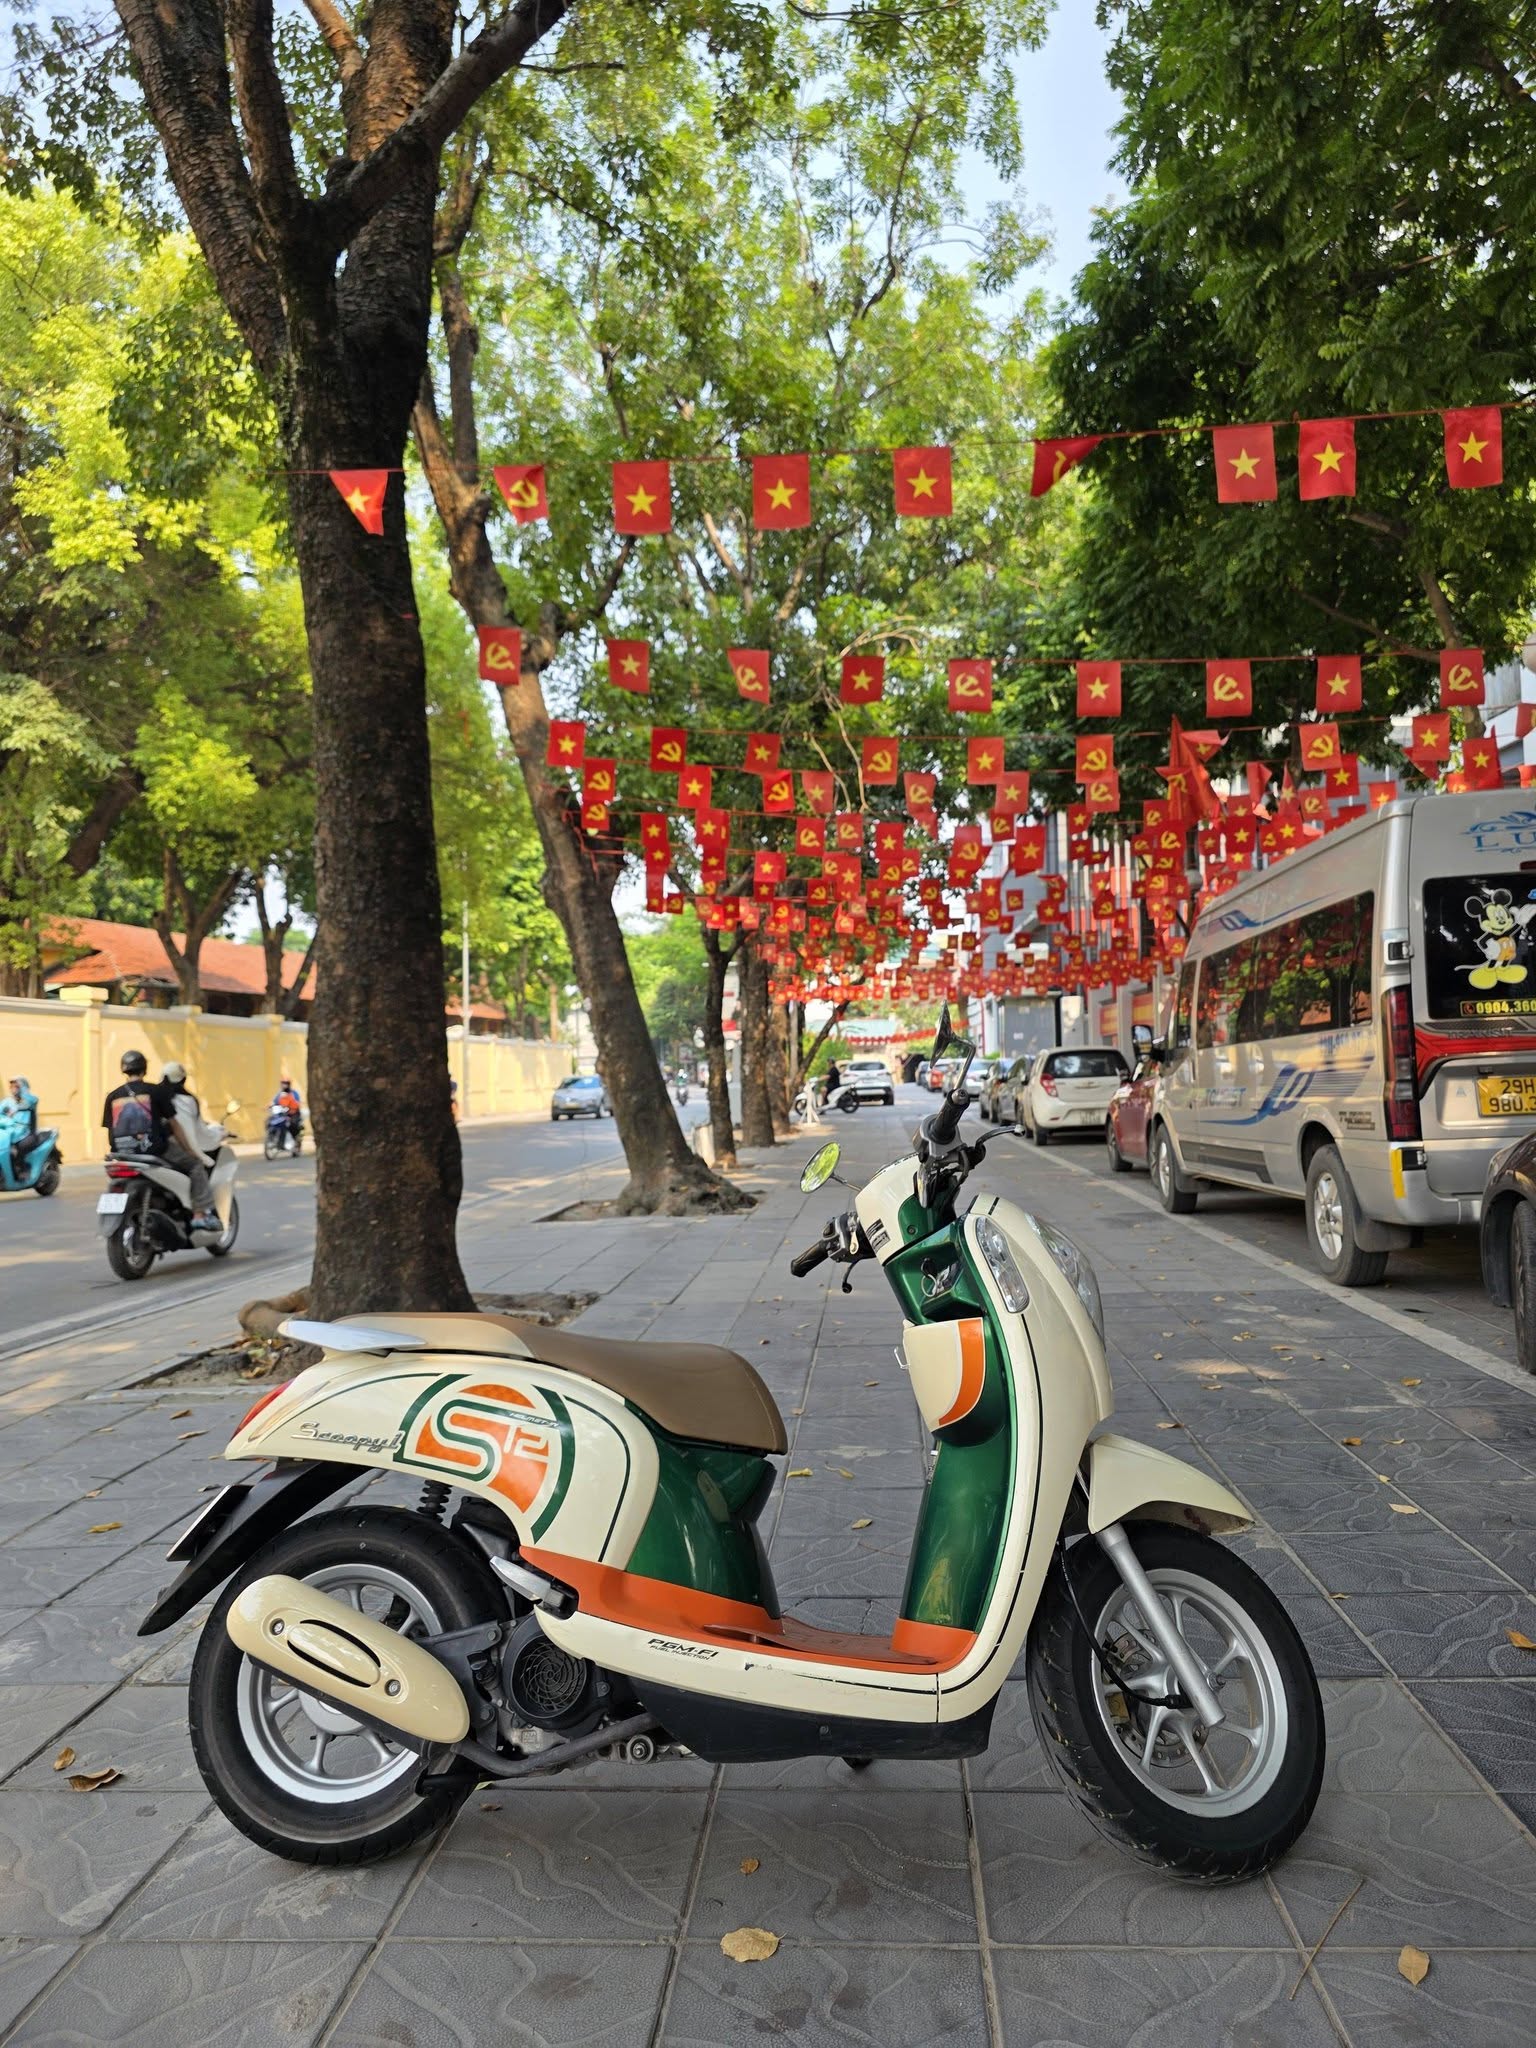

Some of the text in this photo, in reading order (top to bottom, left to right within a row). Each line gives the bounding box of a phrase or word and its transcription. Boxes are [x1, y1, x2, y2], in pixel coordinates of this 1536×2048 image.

[1447, 1028, 1513, 1040] TRANSIT
[650, 1645, 710, 1661] FUEL INJECTION
